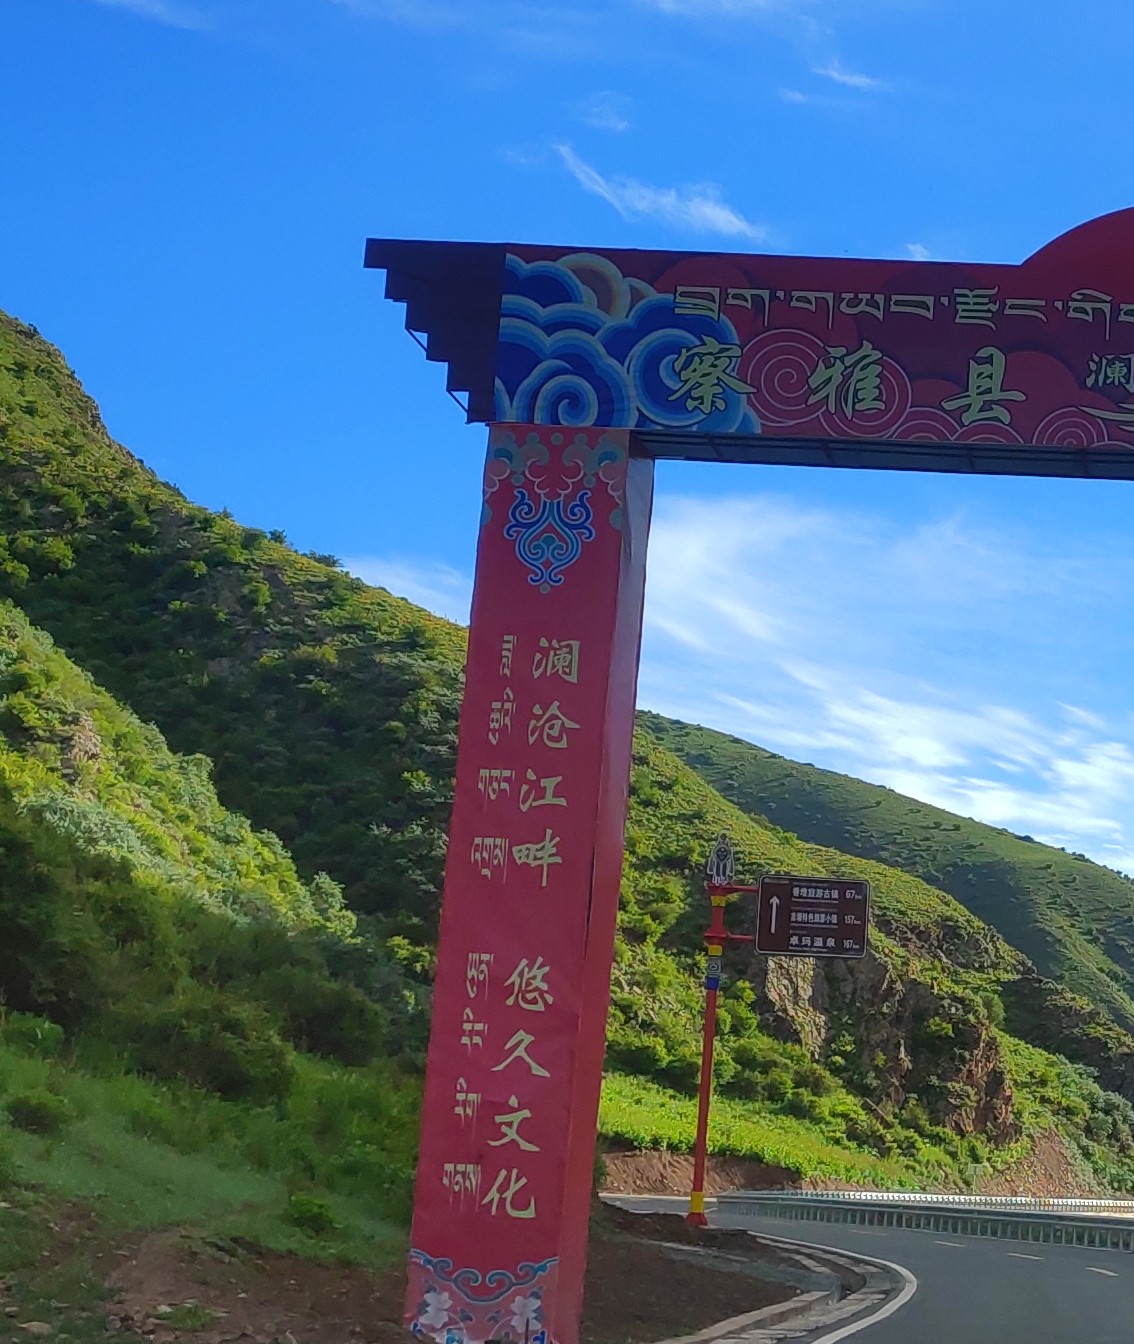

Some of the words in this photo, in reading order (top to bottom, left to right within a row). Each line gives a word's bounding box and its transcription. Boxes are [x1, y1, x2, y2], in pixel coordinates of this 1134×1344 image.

[668, 335, 1026, 426] 察雅县
[511, 636, 581, 887] 澜沧江畔
[480, 954, 553, 1219] 悠久文化
